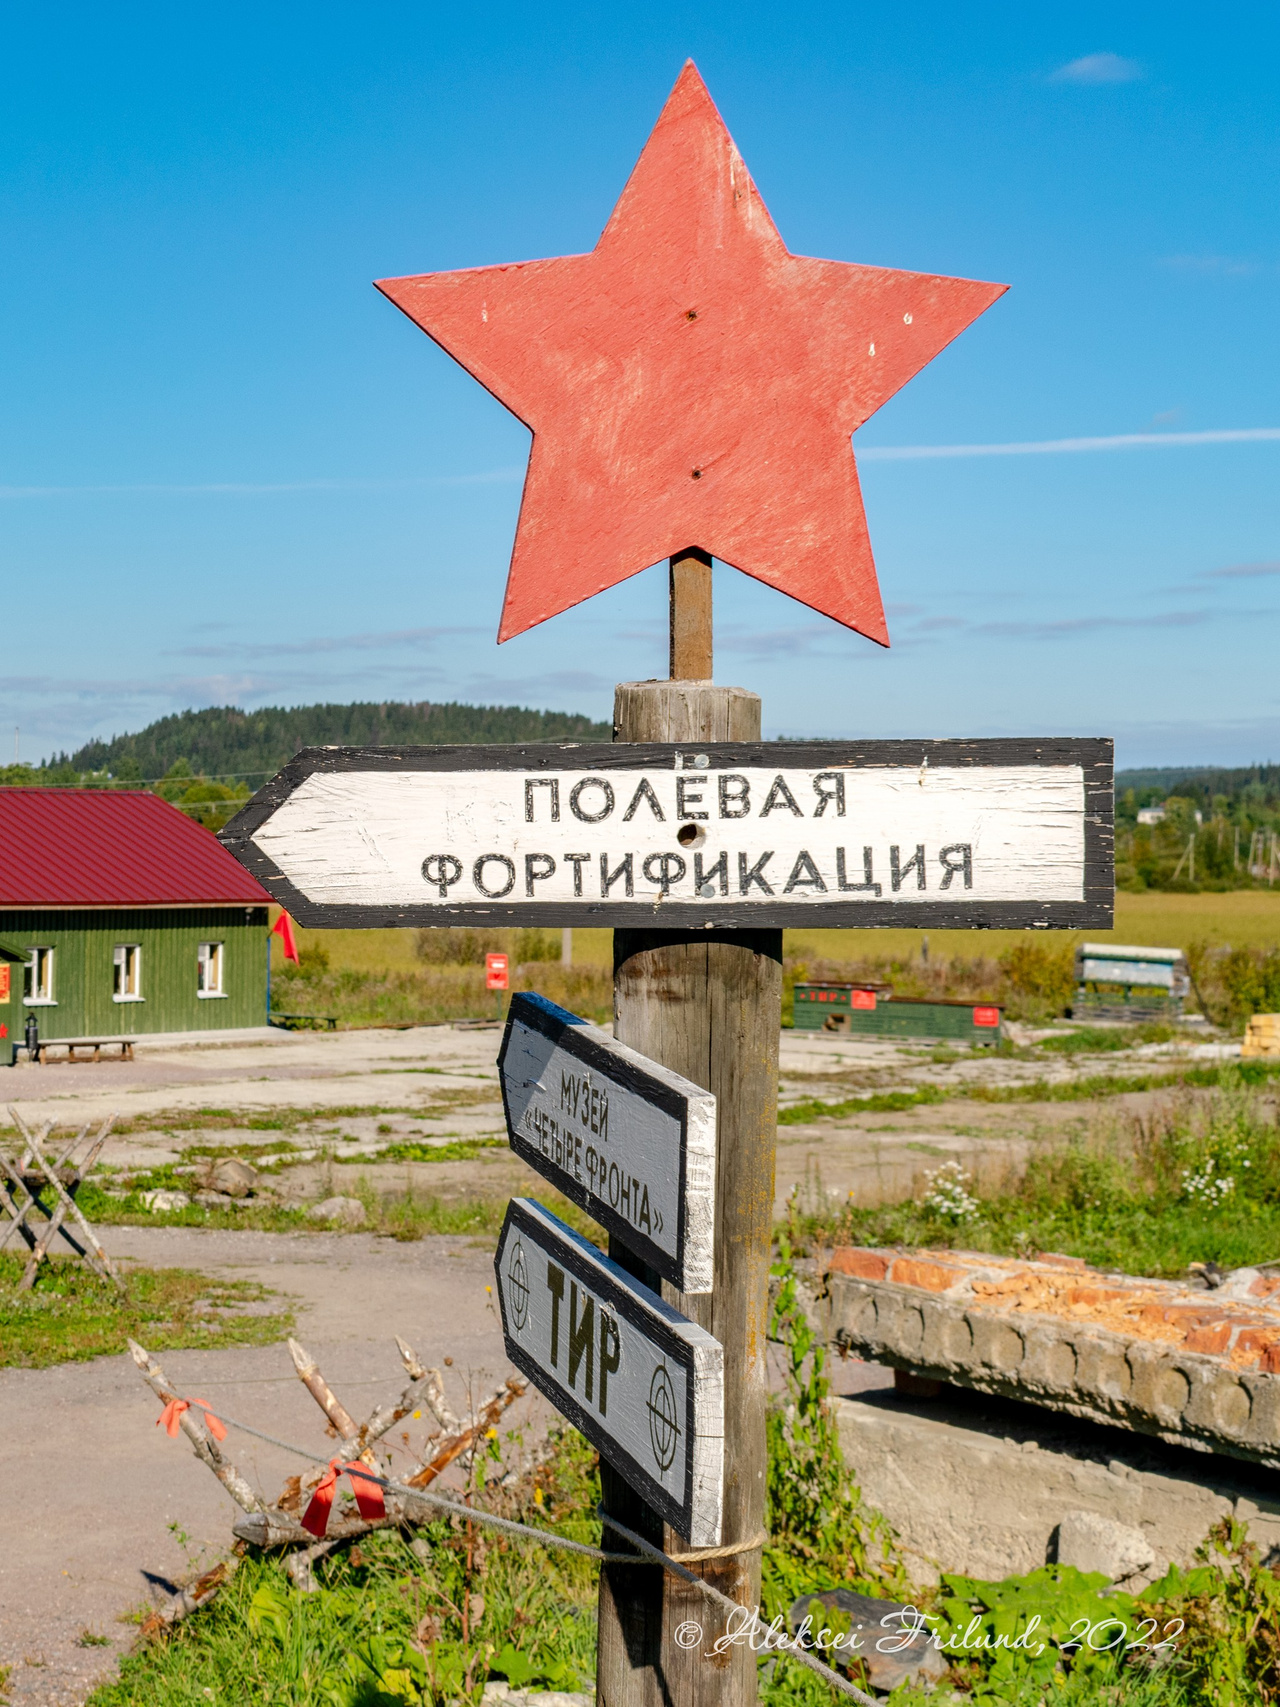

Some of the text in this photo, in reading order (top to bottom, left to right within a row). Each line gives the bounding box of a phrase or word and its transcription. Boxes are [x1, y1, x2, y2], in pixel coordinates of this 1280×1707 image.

[525, 772, 846, 823] ПОЛЕВАЯ
[421, 843, 973, 899] ФОРТИФИКАЦИЯ
[809, 991, 838, 1002] ТИР
[560, 1069, 610, 1142] МУЗЕЙ
[524, 1106, 664, 1236] «ЧЕТЫРЕ ФРОНТА»
[547, 1260, 621, 1419] ТИР
